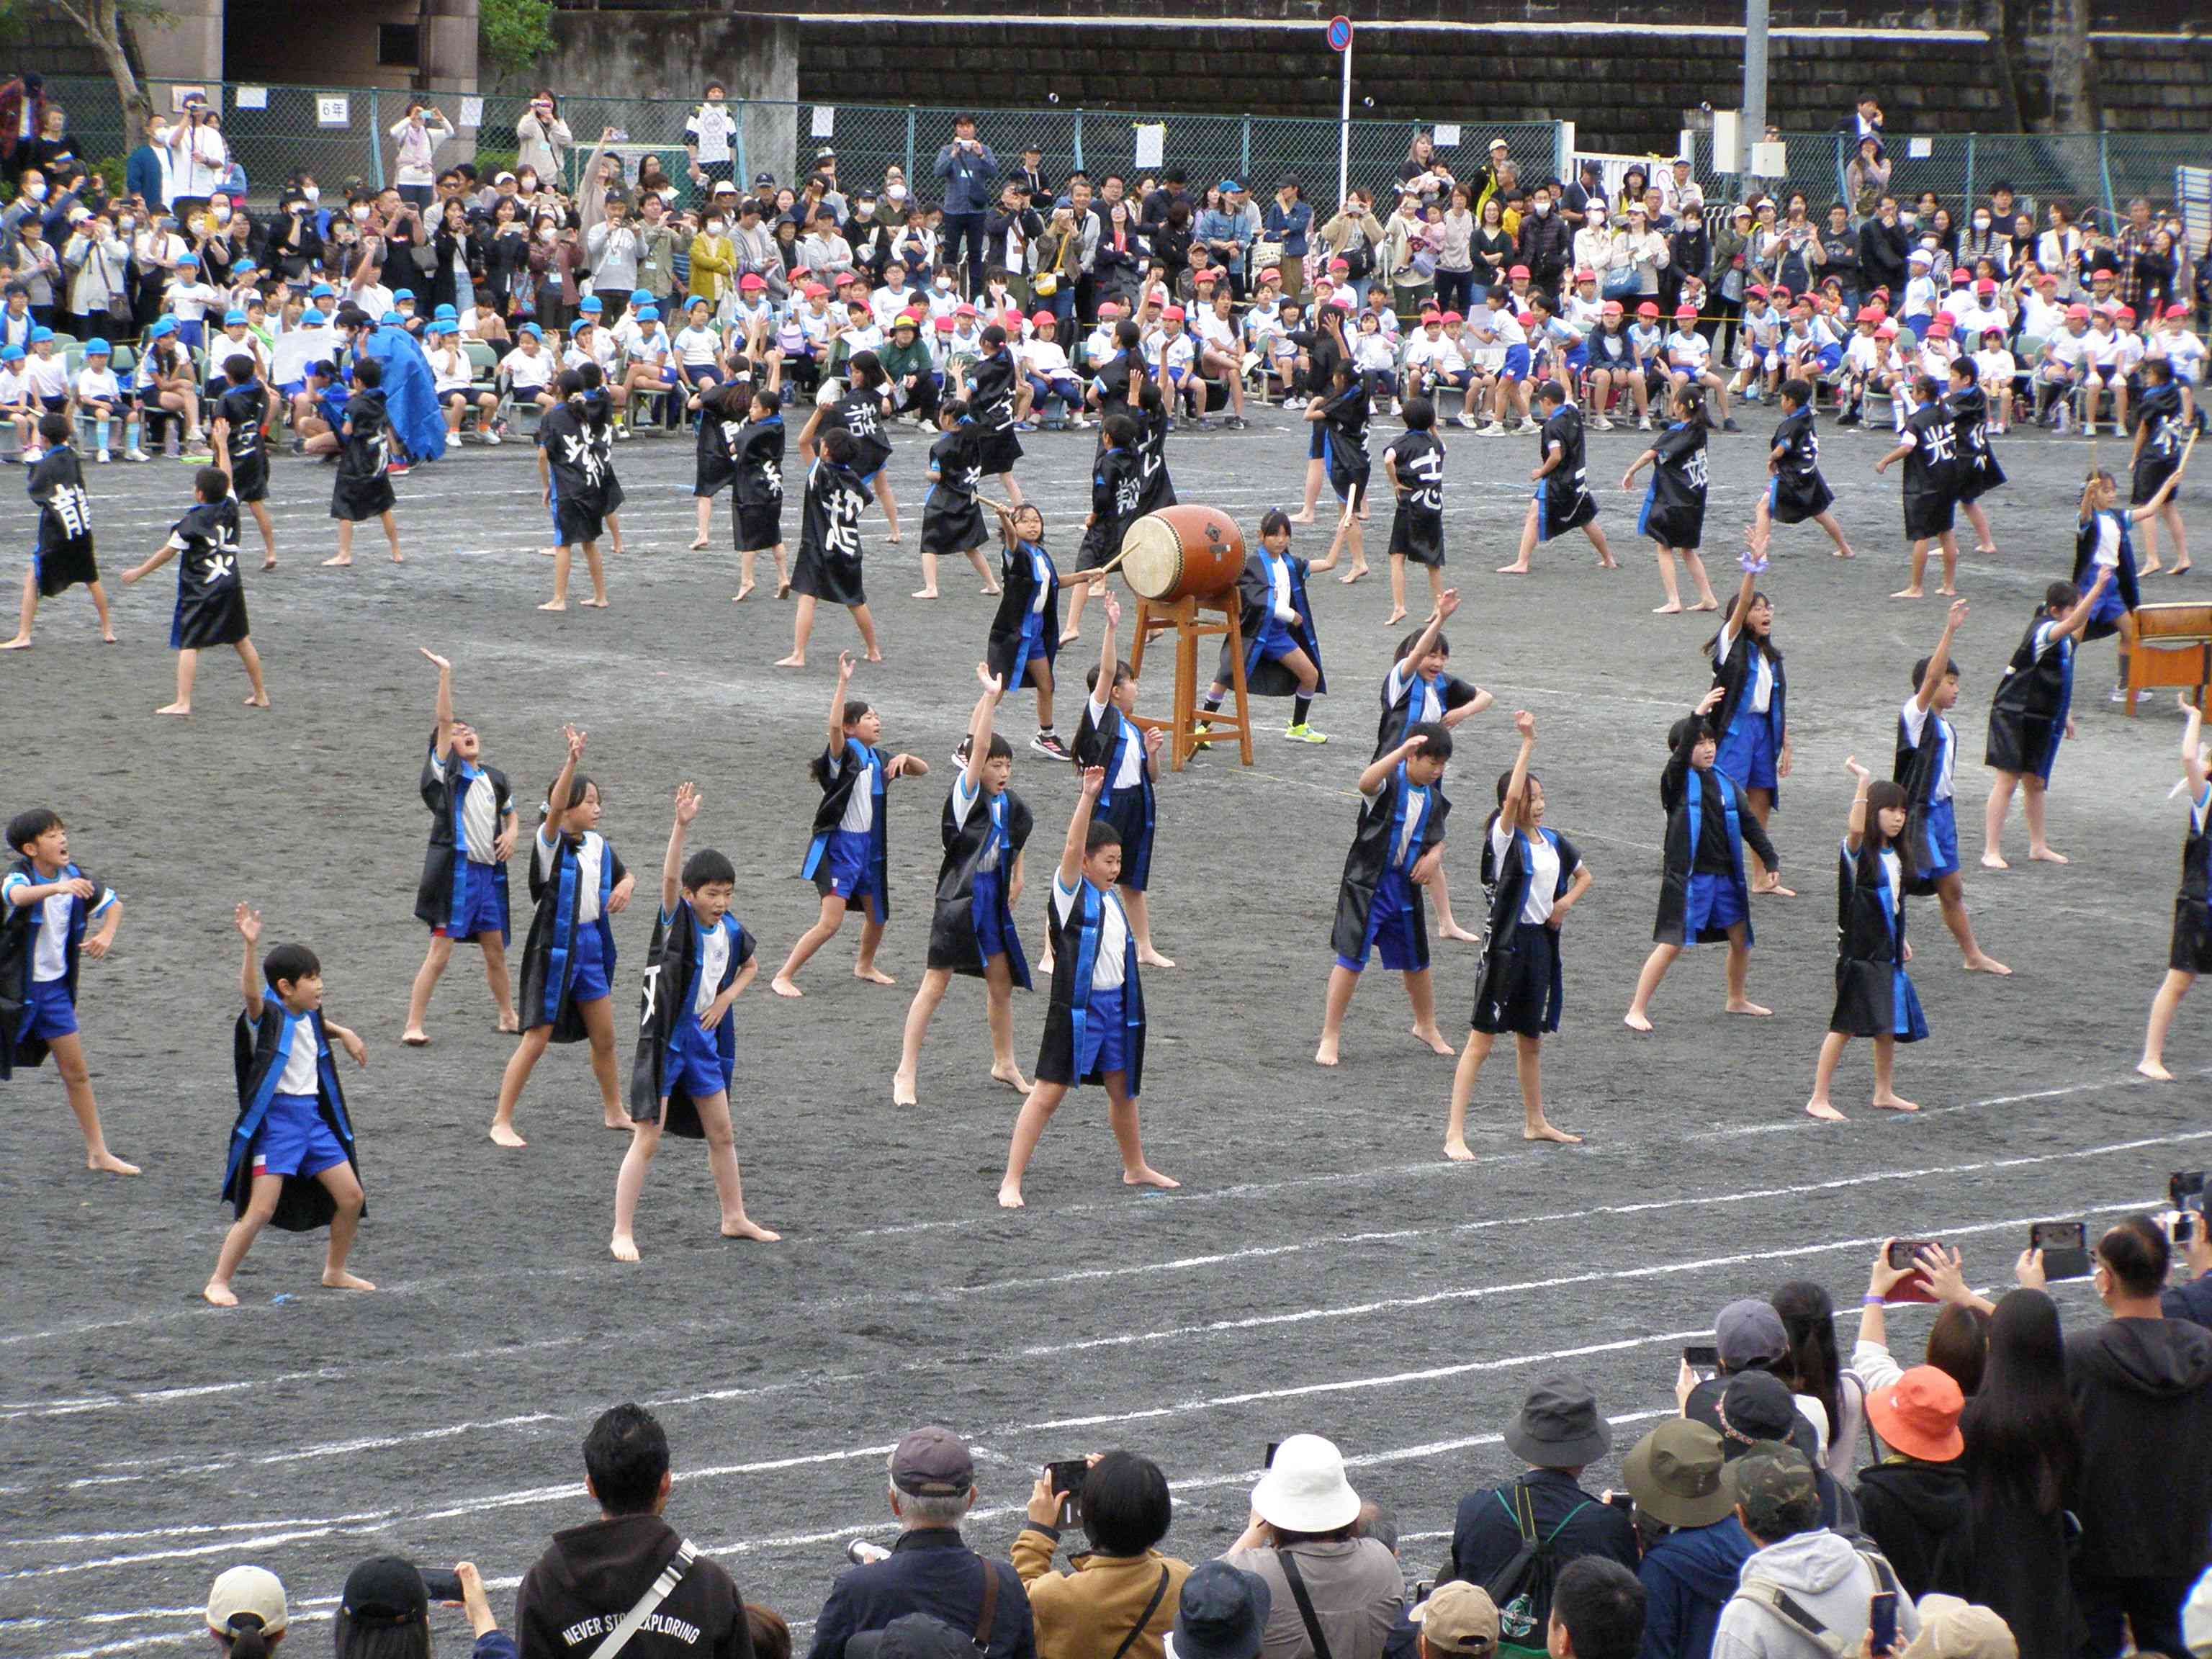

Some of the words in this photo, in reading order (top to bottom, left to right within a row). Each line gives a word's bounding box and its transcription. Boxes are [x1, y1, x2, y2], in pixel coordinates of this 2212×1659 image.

[323, 102, 344, 118] 6年
[1410, 447, 1444, 511] 志
[562, 1617, 603, 1647] NEVER
[605, 1612, 629, 1632] STO
[639, 1614, 701, 1646] XPLORING
